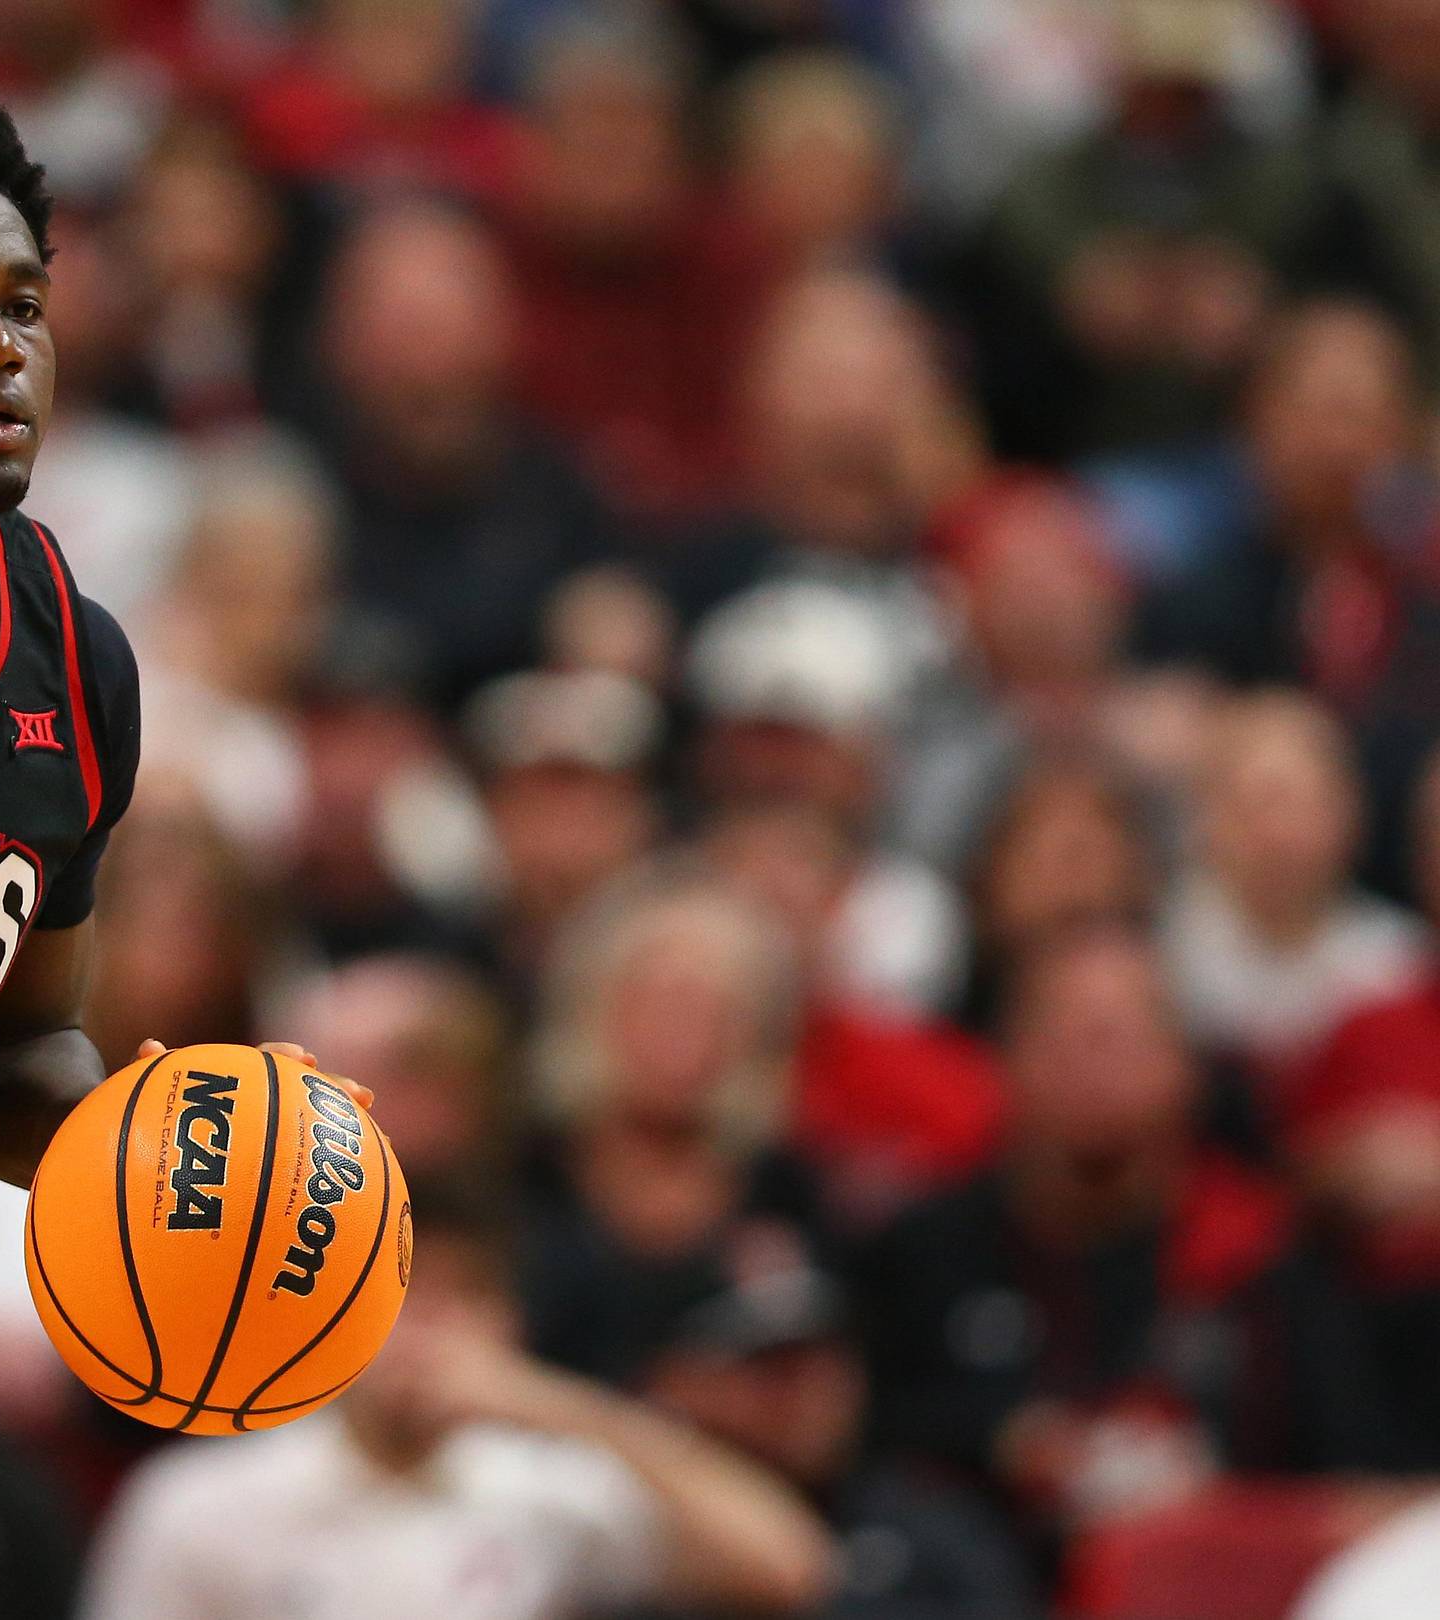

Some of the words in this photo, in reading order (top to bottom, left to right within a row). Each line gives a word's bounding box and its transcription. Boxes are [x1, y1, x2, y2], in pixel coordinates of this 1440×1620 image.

[161, 1070, 182, 1125] OFFICIAL
[157, 1127, 171, 1176] GAME
[166, 1070, 240, 1230] NCAA
[152, 1180, 165, 1229] BALL
[271, 1073, 365, 1297] Wilson
[284, 1188, 298, 1217] BALL
